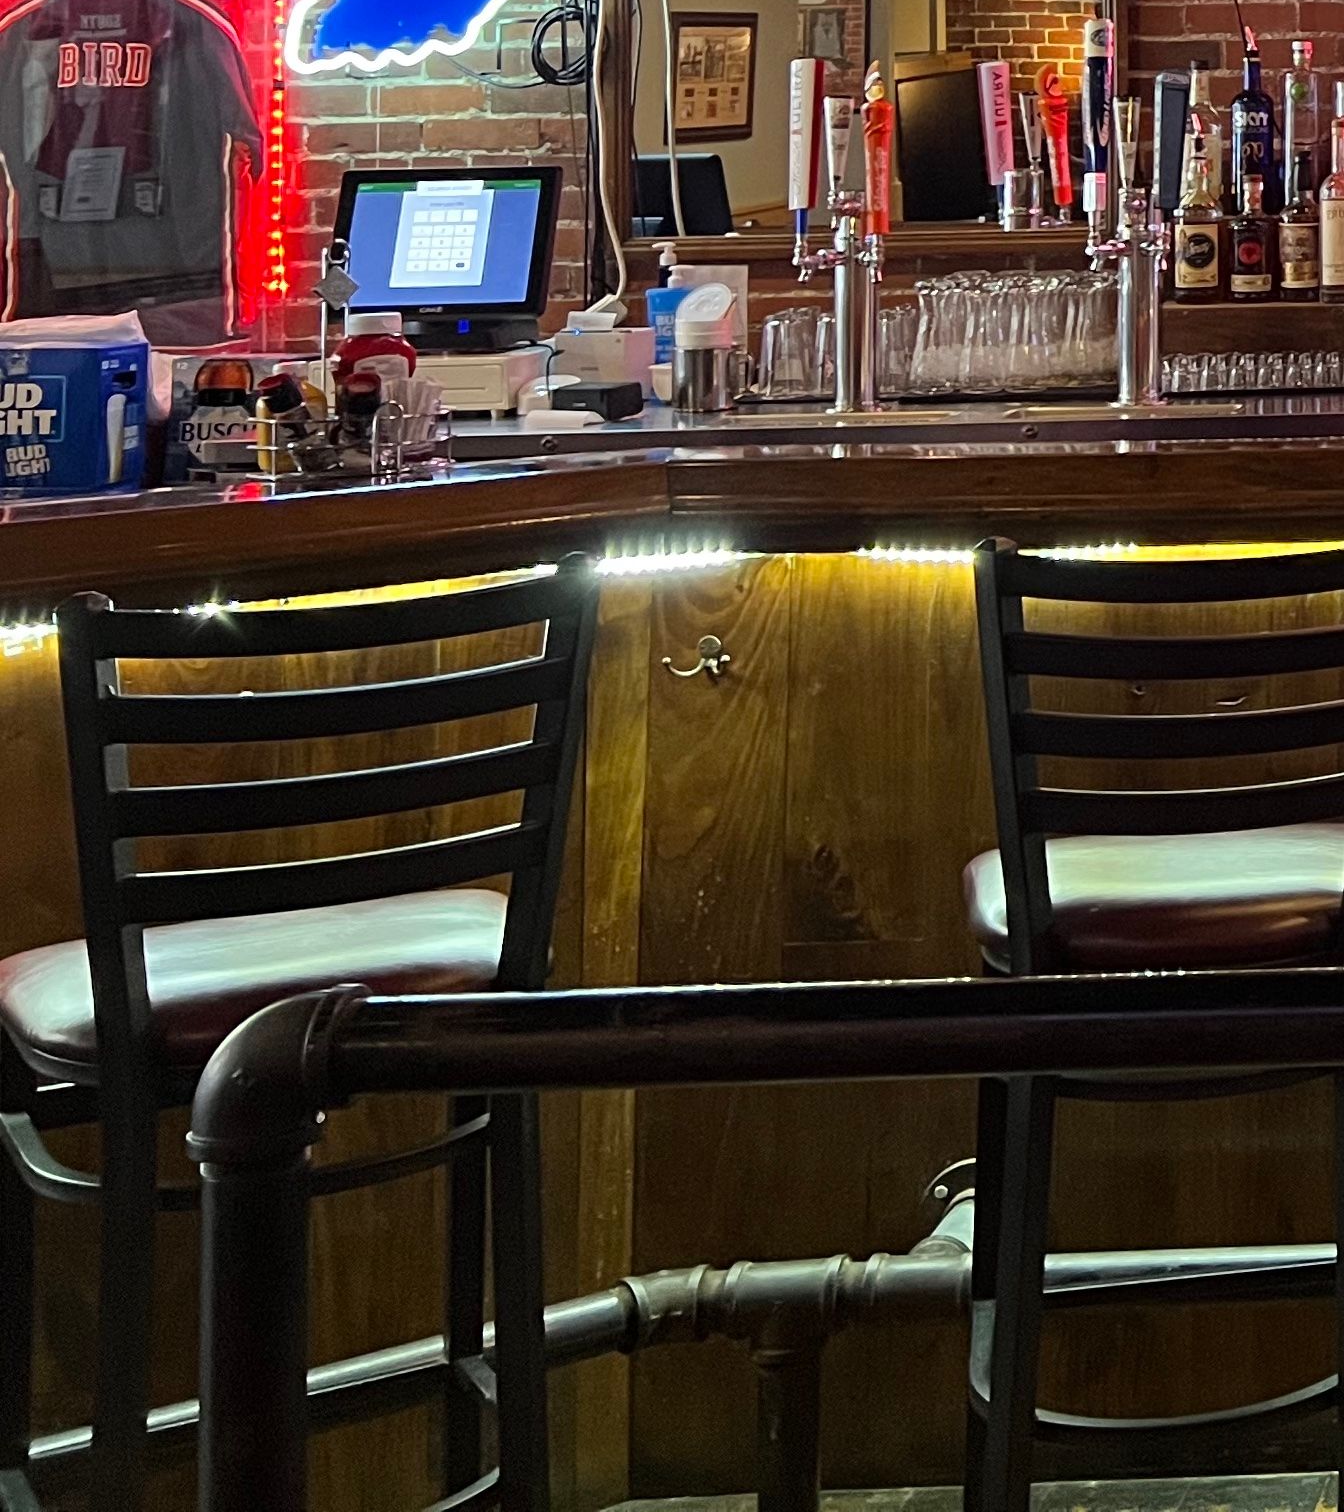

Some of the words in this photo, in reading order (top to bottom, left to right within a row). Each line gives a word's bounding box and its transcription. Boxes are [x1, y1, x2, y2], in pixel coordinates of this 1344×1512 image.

[57, 42, 153, 89] BIRD
[1235, 111, 1269, 127] SKYY
[176, 362, 188, 370] 12
[0, 383, 43, 409] UD
[182, 422, 257, 442] BUSC
[6, 444, 46, 462] BUD
